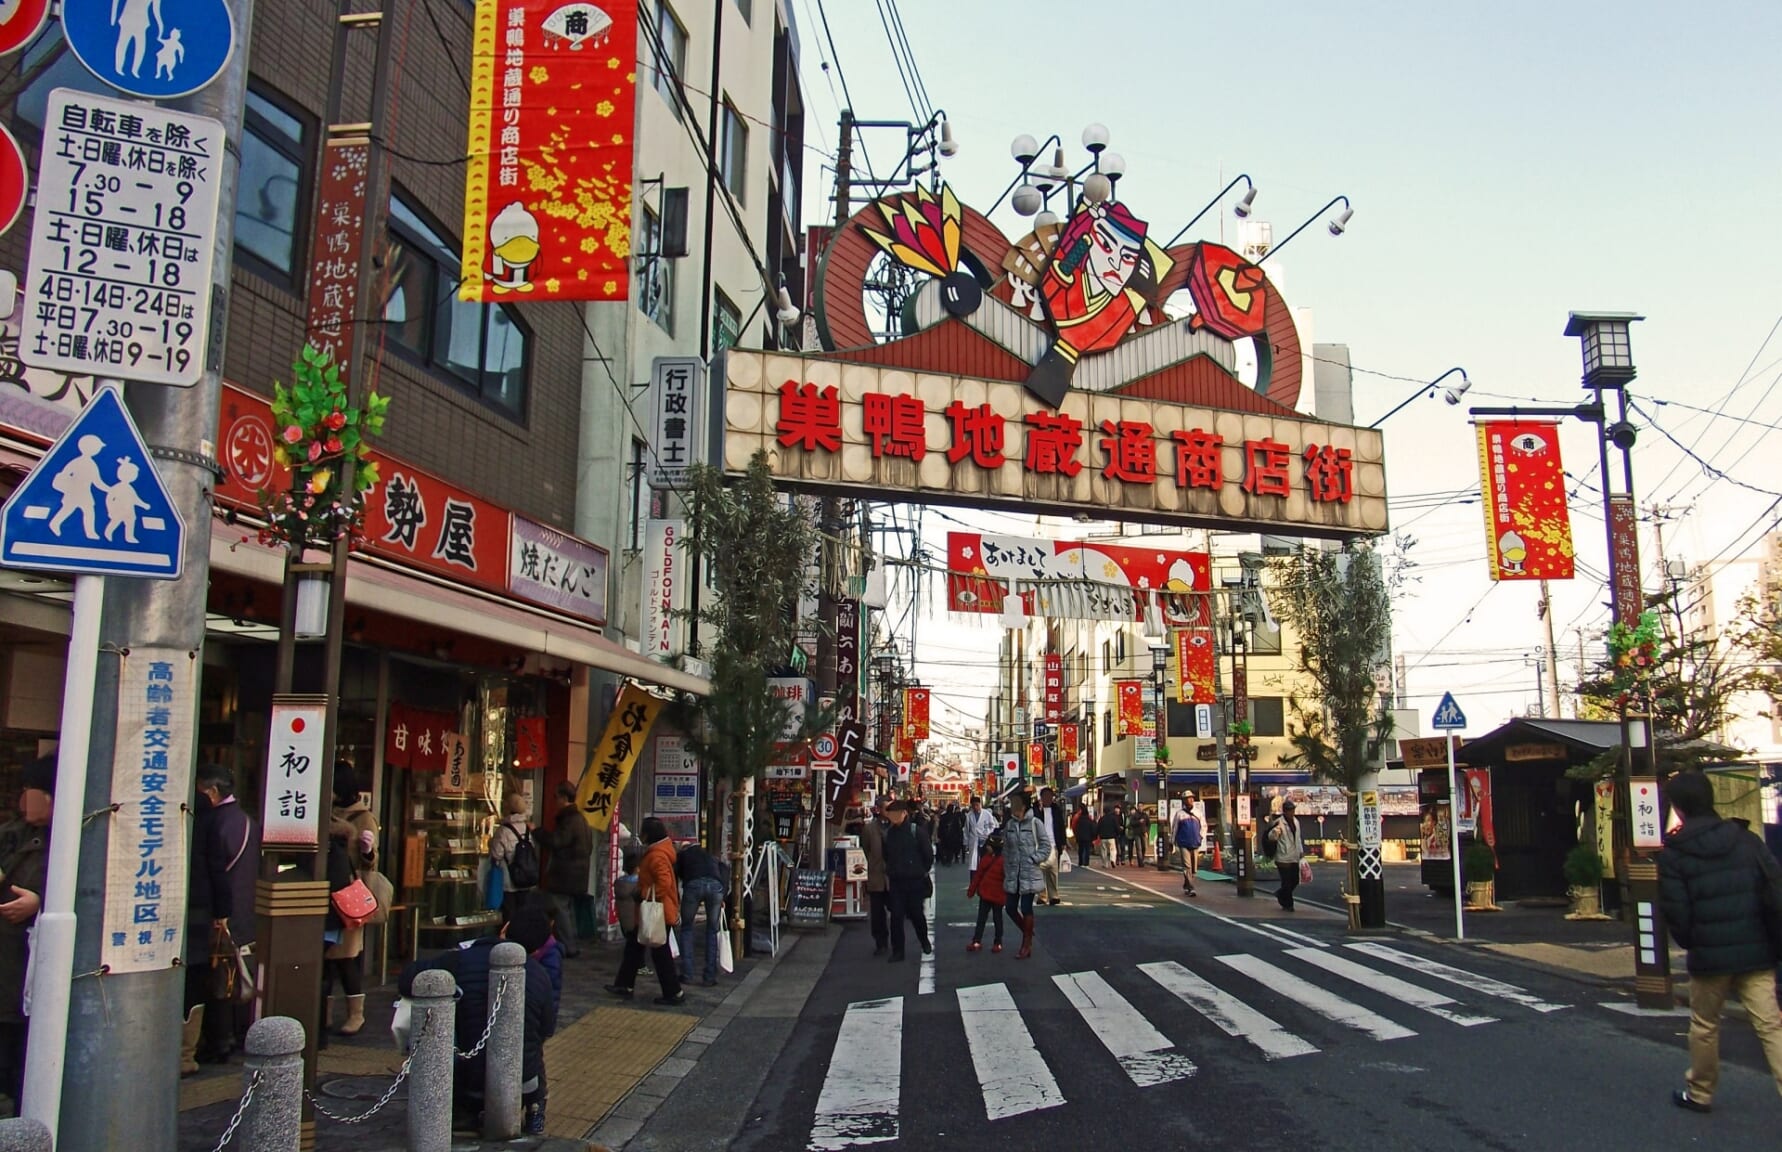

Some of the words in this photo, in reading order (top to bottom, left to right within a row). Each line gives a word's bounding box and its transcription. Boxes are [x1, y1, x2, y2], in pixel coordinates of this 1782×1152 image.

[565, 11, 588, 36] 商
[61, 103, 210, 153] 自転車を除く
[499, 7, 526, 187] 巣鴨地蔵通り商店街
[319, 201, 351, 361] 巣鴨地蔵通り
[663, 369, 688, 462] 行政書士
[776, 379, 1353, 504] 巣鴨地蔵通商店街
[353, 472, 478, 572] 勢屋
[982, 541, 1047, 568] あけまして
[520, 541, 596, 598] 焼だんご
[1087, 593, 1142, 616] ございま
[817, 740, 833, 753] 30
[133, 661, 173, 924] 高齢者交通安全モデル地区
[278, 745, 310, 820] 初詣
[1637, 800, 1655, 837] 初詣
